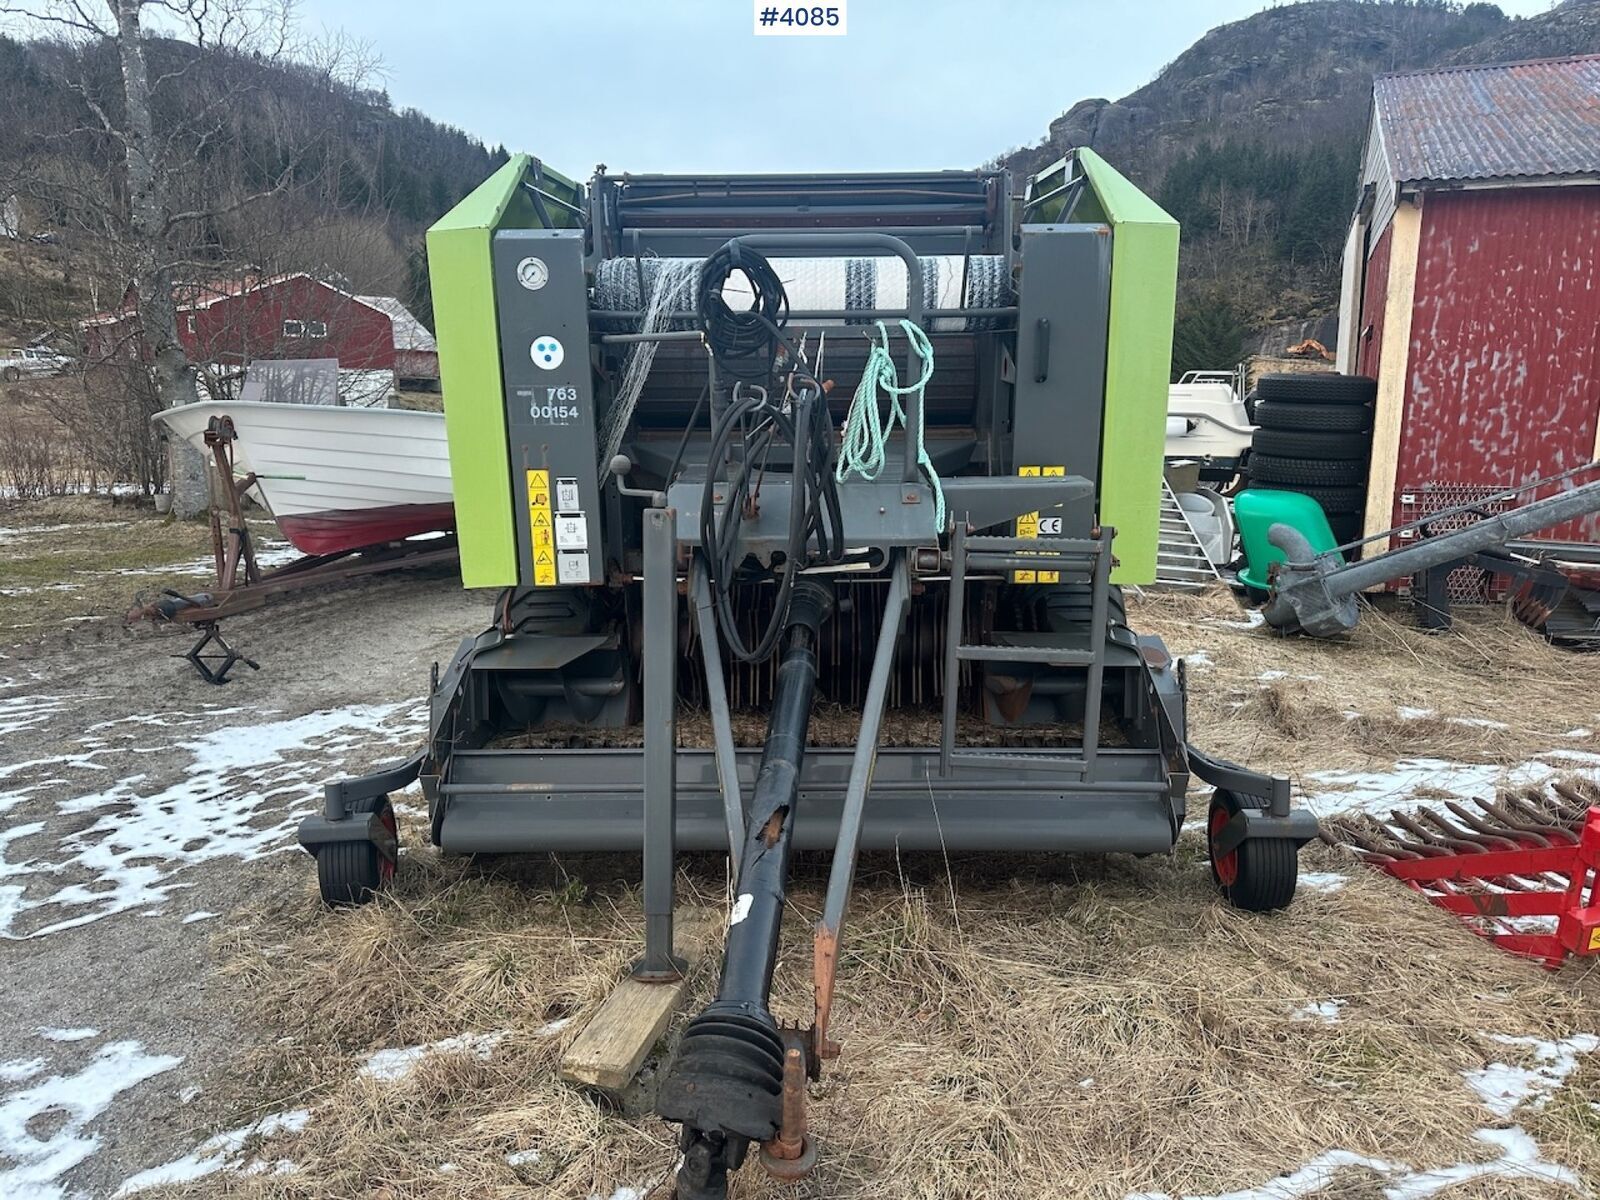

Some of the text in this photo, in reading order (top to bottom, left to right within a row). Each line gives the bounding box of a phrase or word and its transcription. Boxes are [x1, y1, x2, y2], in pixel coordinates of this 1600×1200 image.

[547, 388, 577, 401] 763
[530, 406, 579, 418] 00154
[1039, 519, 1060, 533] CE
